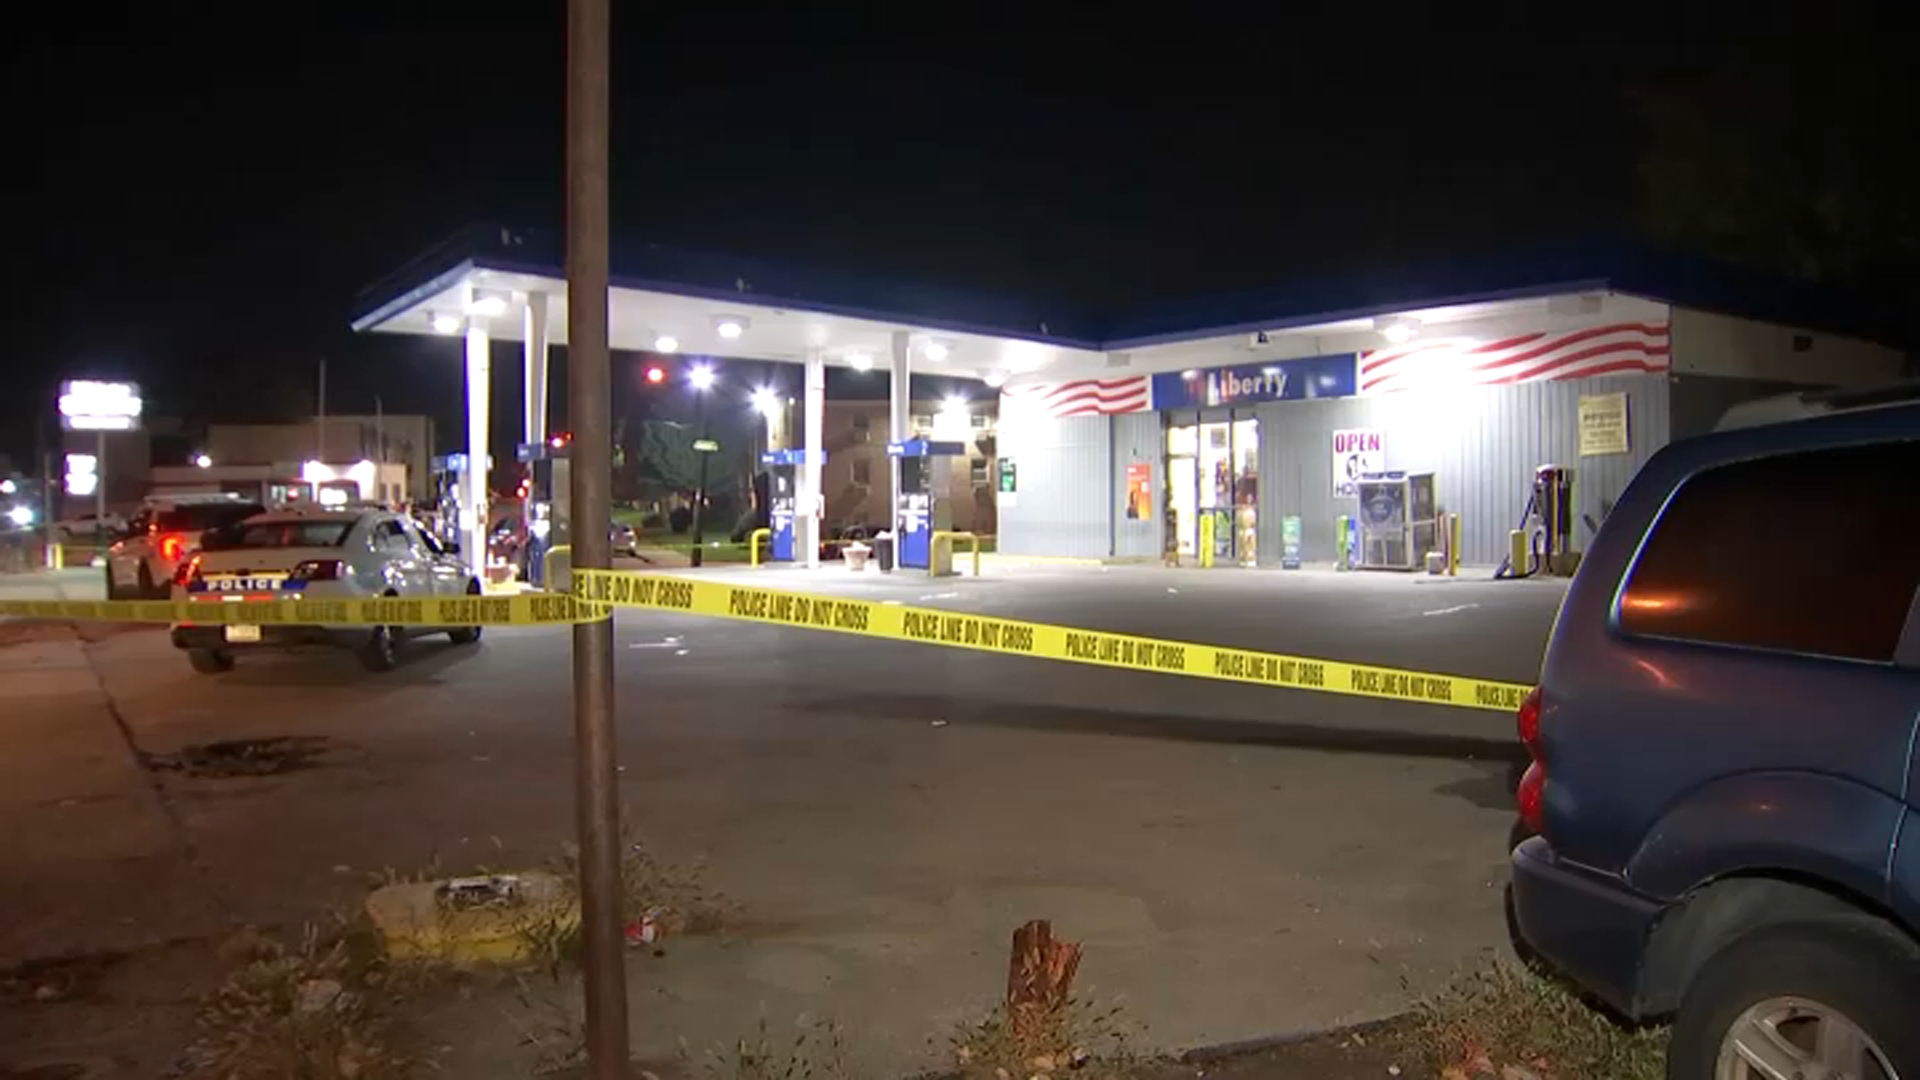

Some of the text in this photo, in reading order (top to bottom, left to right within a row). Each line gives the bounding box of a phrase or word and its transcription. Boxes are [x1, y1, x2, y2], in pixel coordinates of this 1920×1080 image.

[1335, 433, 1380, 453] OPEN
[207, 578, 282, 590] POLICE
[614, 576, 630, 602] DO
[631, 578, 656, 604] NOT
[657, 580, 693, 609] CROSS
[729, 589, 870, 630] POLICE LINE DO NOT CROSS
[903, 611, 1034, 652] POLICE LINE DO NOT CROSS
[1066, 633, 1186, 671] POLICE LINE DO NOT CROSS
[1215, 652, 1324, 687] POLICE LINE DO NOT CROSS
